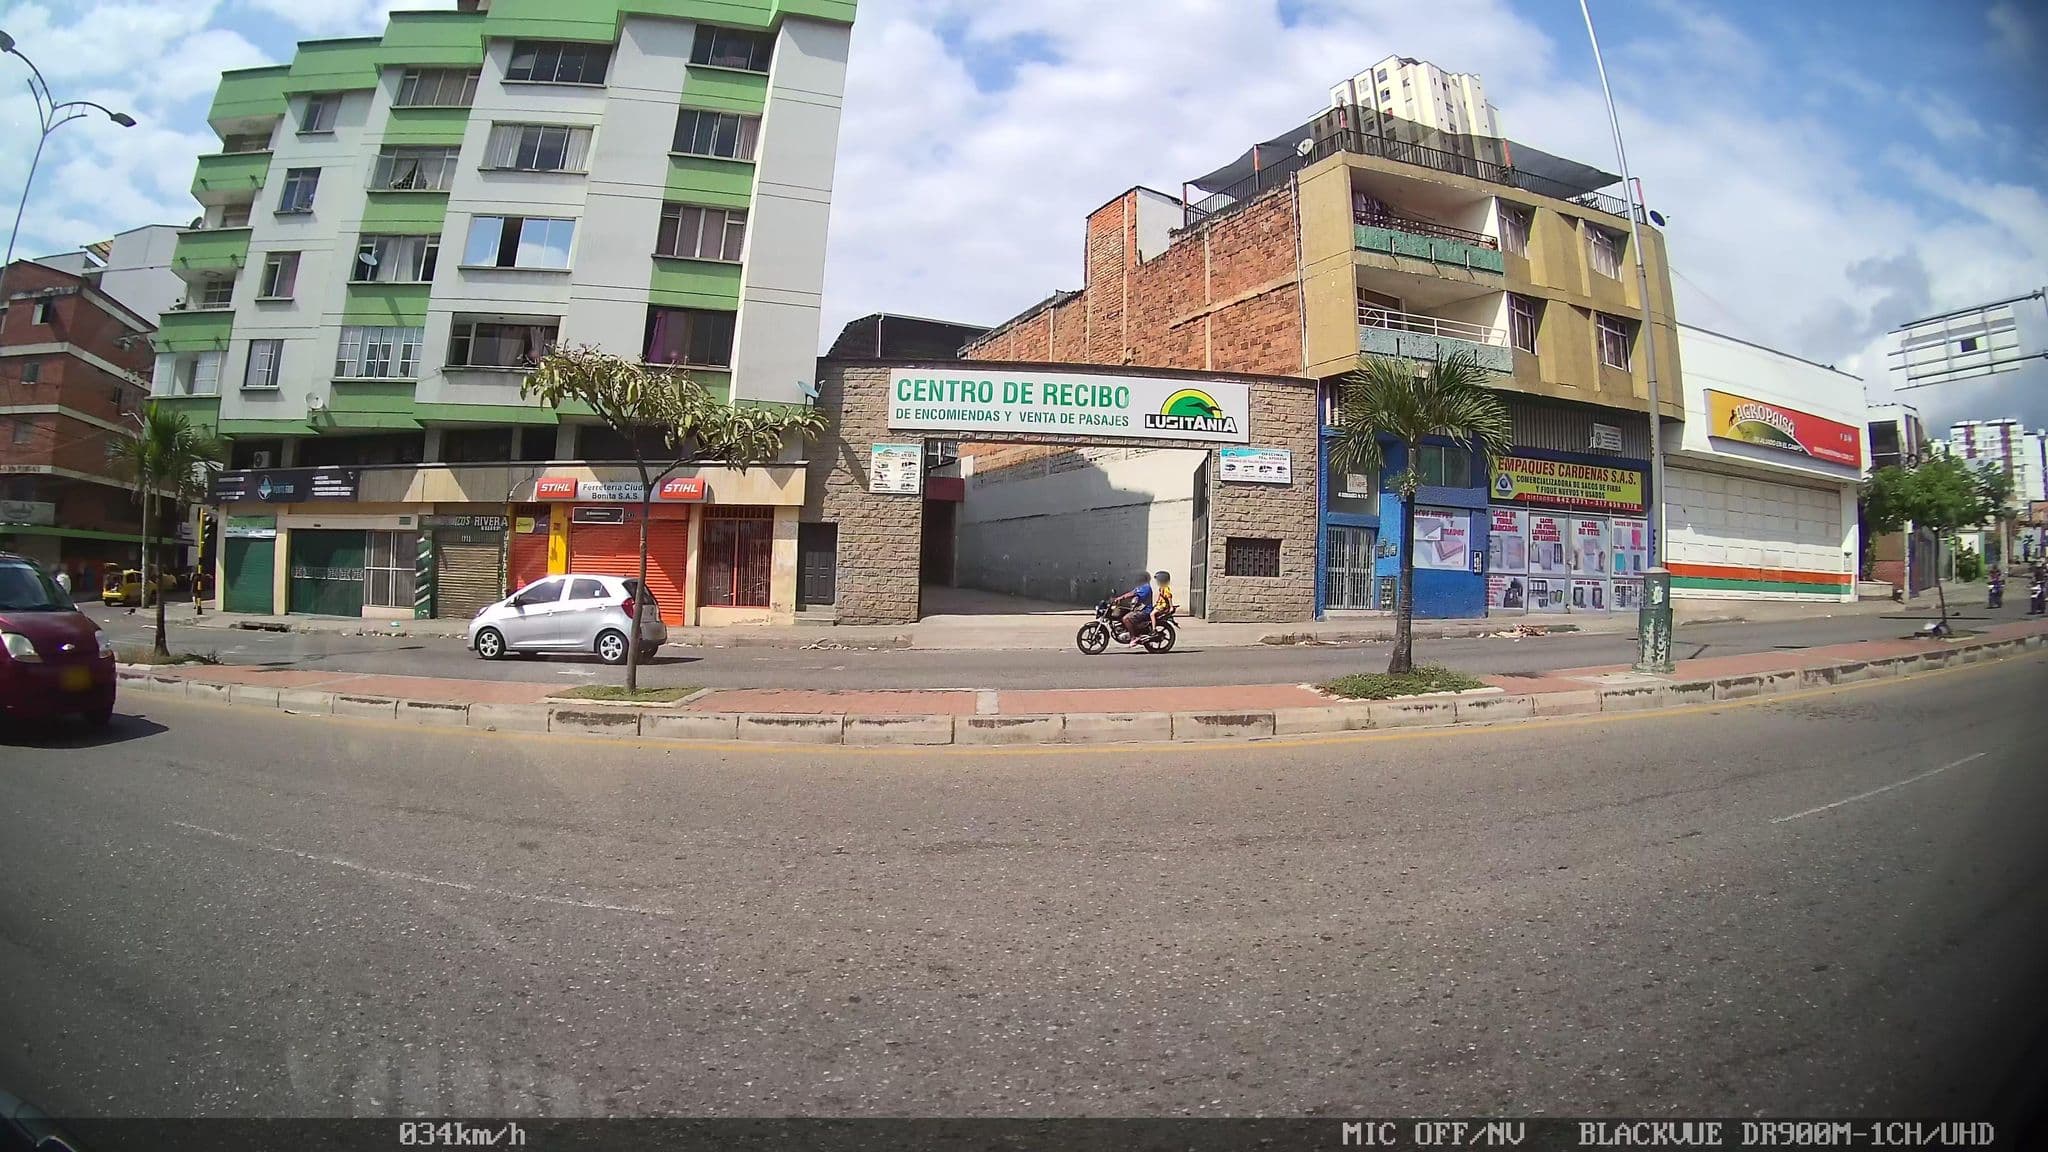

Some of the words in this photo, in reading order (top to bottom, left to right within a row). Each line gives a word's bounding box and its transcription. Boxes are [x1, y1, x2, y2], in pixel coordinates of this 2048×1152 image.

[897, 378, 993, 404] CENTRO
[1003, 381, 1034, 405] DE
[1043, 383, 1130, 409] RECIBO
[896, 408, 911, 420] DE
[915, 408, 1000, 422] ENCOMIENDAS
[1004, 411, 1012, 422] Y
[1019, 411, 1056, 424] VENTA
[1060, 412, 1075, 424] DE
[1079, 413, 1129, 427] PASAJES
[1145, 414, 1238, 433] LUSITANIA
[1735, 403, 1796, 437] AGROPAISA
[1498, 456, 1555, 476] EMPAQUES
[1558, 464, 1609, 482] CARDENAS
[1611, 470, 1637, 485] S.A.S.
[540, 483, 571, 492] STIHL
[625, 483, 644, 491] Ciud
[663, 484, 698, 493] STIHL
[1516, 475, 1572, 488] COMERCIALIZADORA
[1581, 482, 1598, 490] SACOS
[1607, 484, 1622, 493] FIBRA
[591, 492, 616, 500] Bonita
[1541, 486, 1558, 494] FIQUE
[1559, 488, 1579, 497] NUEVOS
[1585, 490, 1605, 499] USADOS
[474, 516, 507, 527] RIVERA
